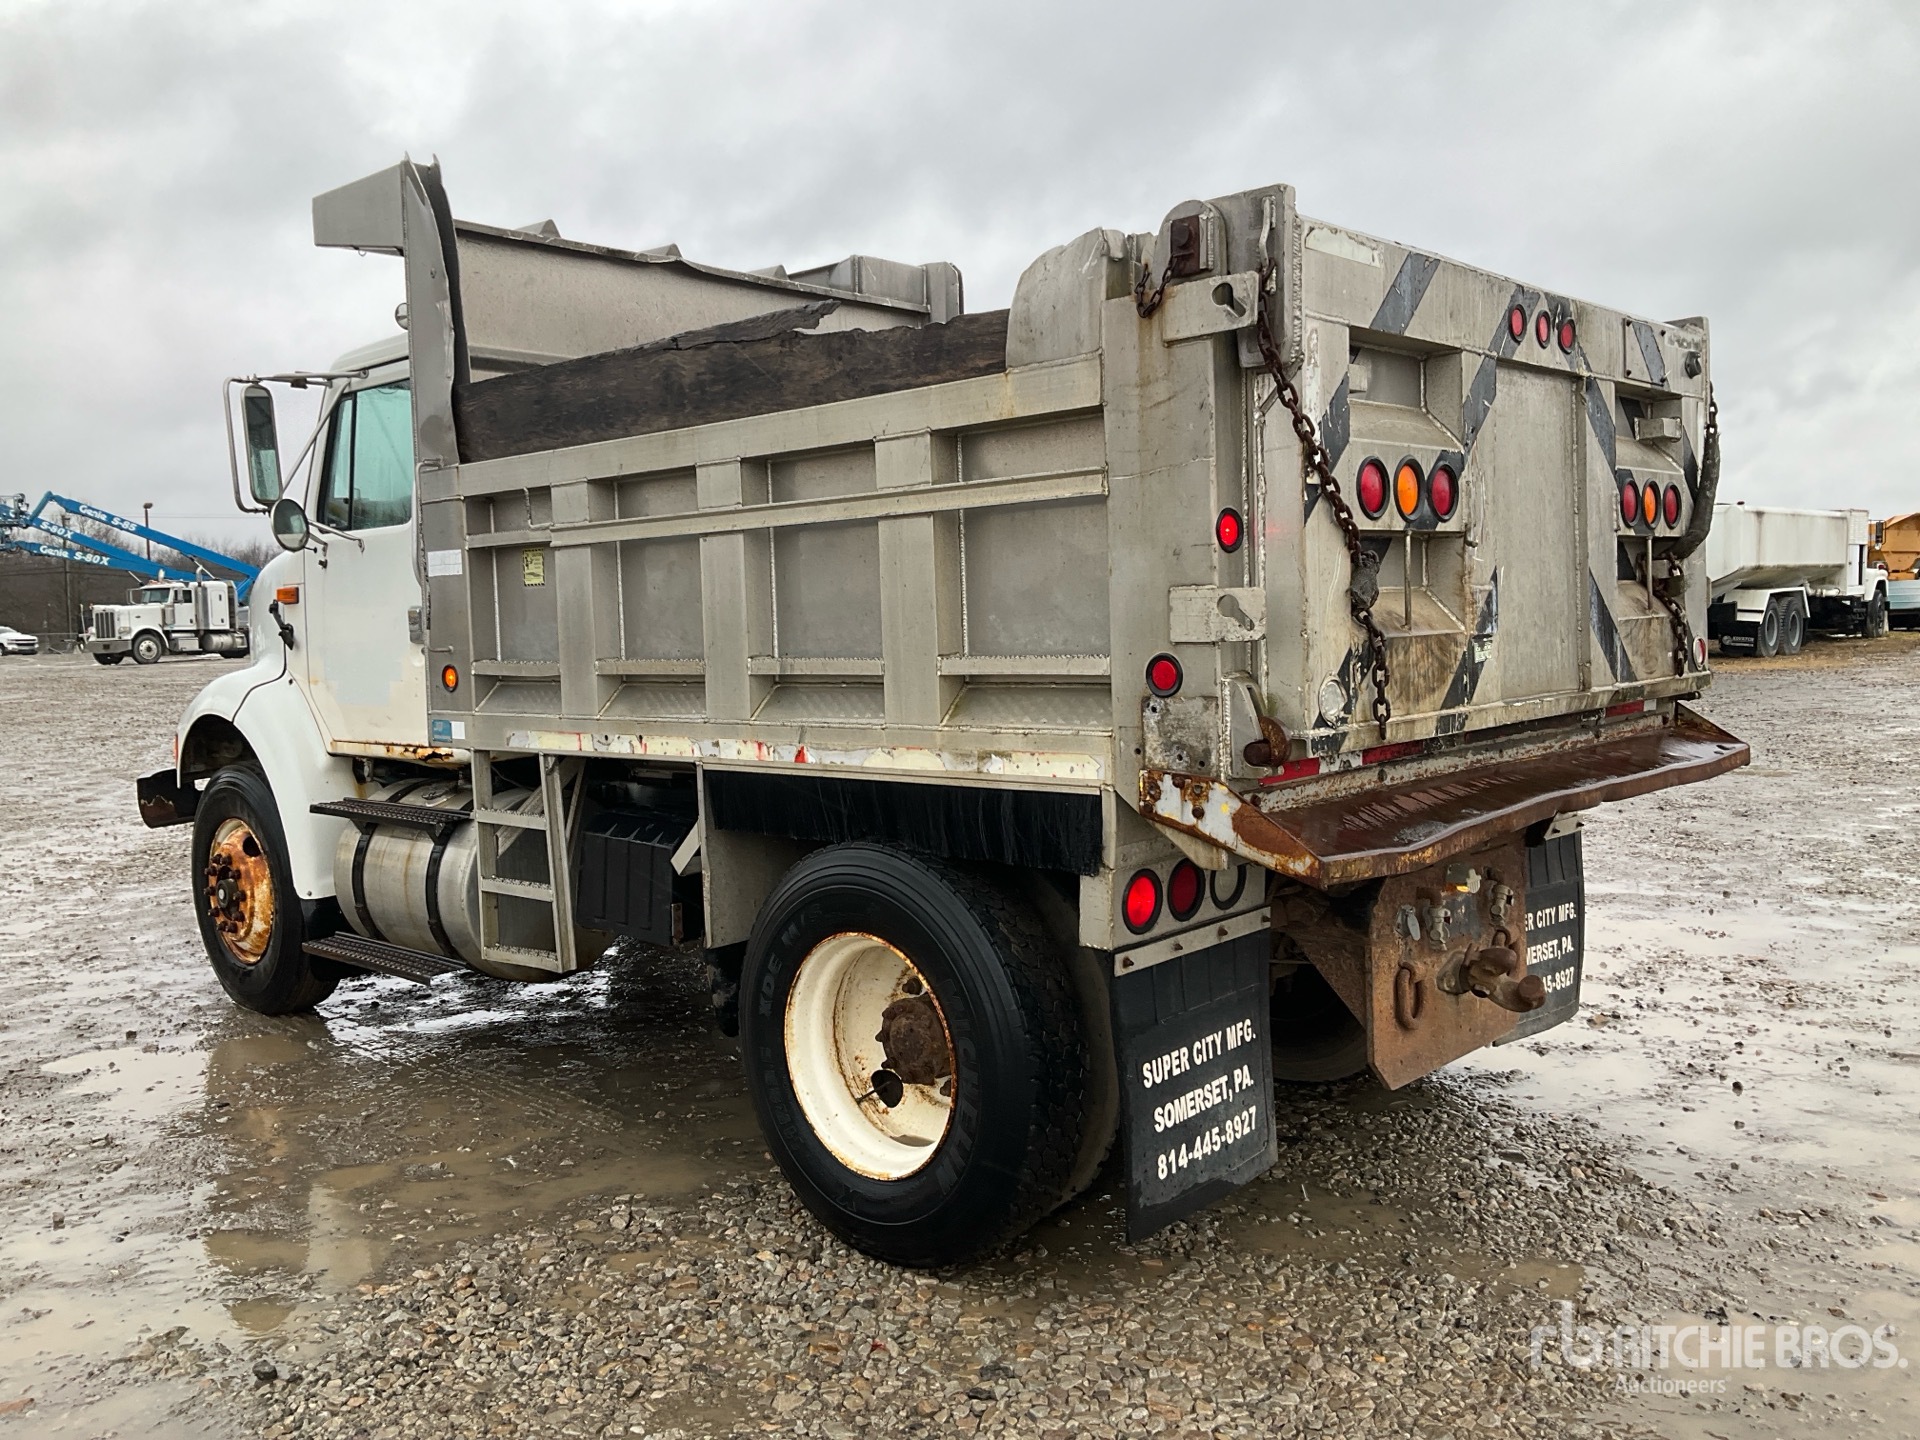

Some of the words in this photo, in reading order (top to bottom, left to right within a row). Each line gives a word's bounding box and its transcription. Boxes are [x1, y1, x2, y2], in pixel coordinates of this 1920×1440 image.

[40, 521, 75, 539] S-80X
[79, 504, 108, 520] Genie
[111, 516, 138, 532] S-85
[40, 545, 70, 559] Genie
[73, 551, 111, 566] S-80X
[1536, 907, 1556, 928] CITY
[1558, 902, 1577, 922] MFG.
[1526, 939, 1561, 966] MERSET,
[758, 952, 783, 1017] XDE
[1142, 1046, 1190, 1089] SUPER
[1192, 1030, 1223, 1066] CITY
[1226, 1018, 1257, 1052] MFG.
[936, 978, 980, 1195] MICHELIN
[1153, 1075, 1233, 1133] SOMERSET,
[1233, 1064, 1255, 1091] PA.
[1157, 1105, 1257, 1181] 814-445-8927
